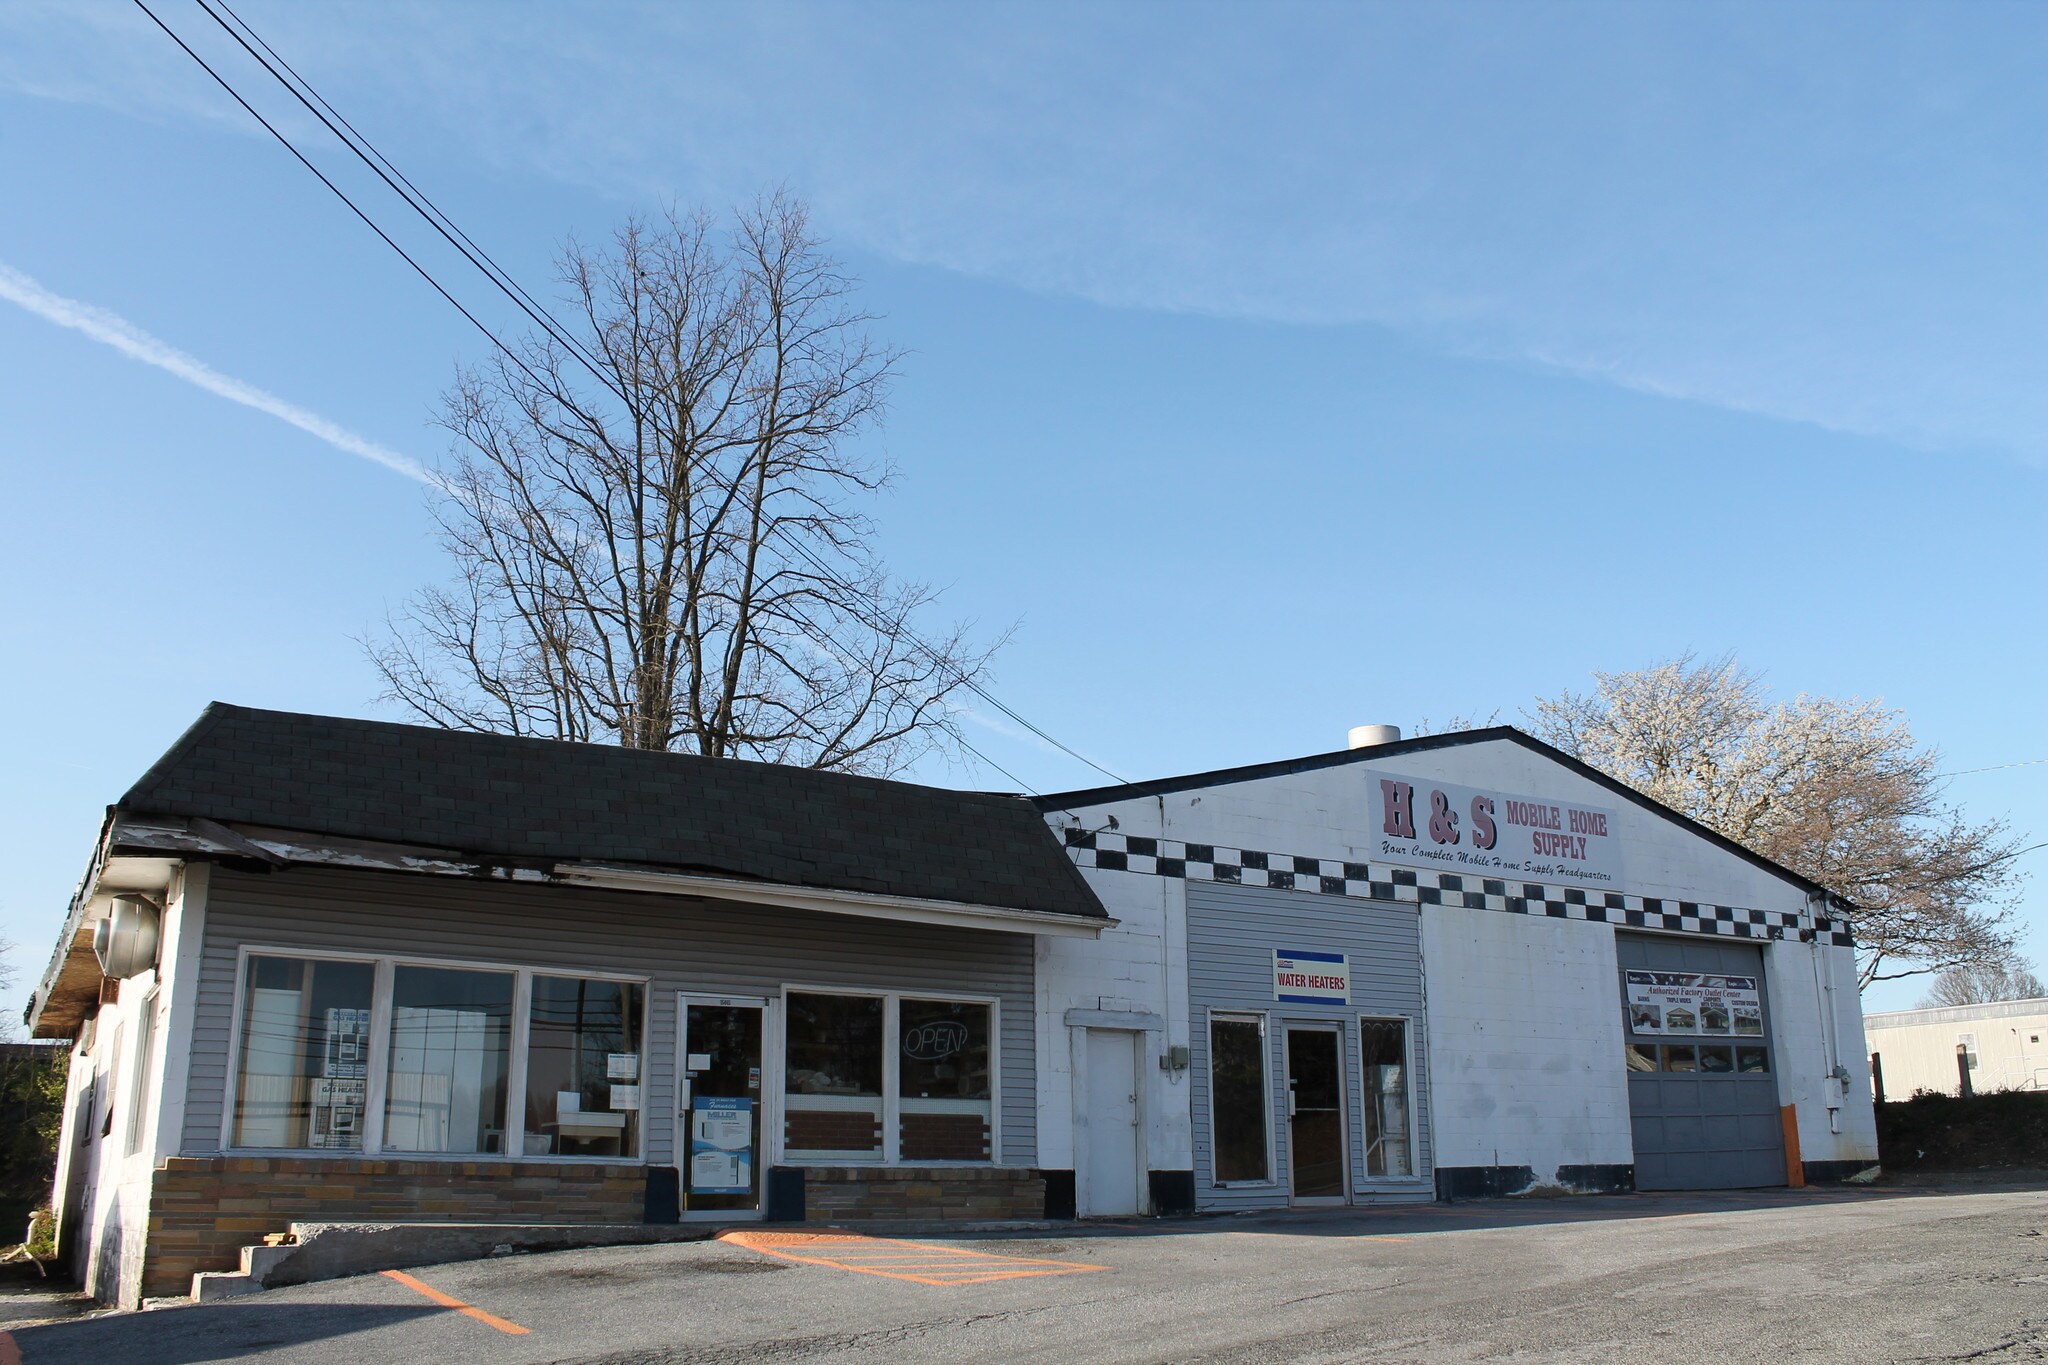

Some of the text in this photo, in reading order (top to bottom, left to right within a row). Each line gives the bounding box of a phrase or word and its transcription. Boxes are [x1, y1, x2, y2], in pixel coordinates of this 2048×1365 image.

[1380, 779, 1497, 850] H & S
[1506, 800, 1608, 837] MOBILE HOME
[1532, 831, 1587, 861] SUPPLY
[1381, 840, 1612, 881] Your Complete Mobile Home Supply Headquarters
[1277, 972, 1345, 990] WATER HEATERS
[1647, 985, 1741, 999] Authorized Factory Outlet Center
[905, 1028, 962, 1052] OPEN
[709, 1101, 737, 1109] Furnaces
